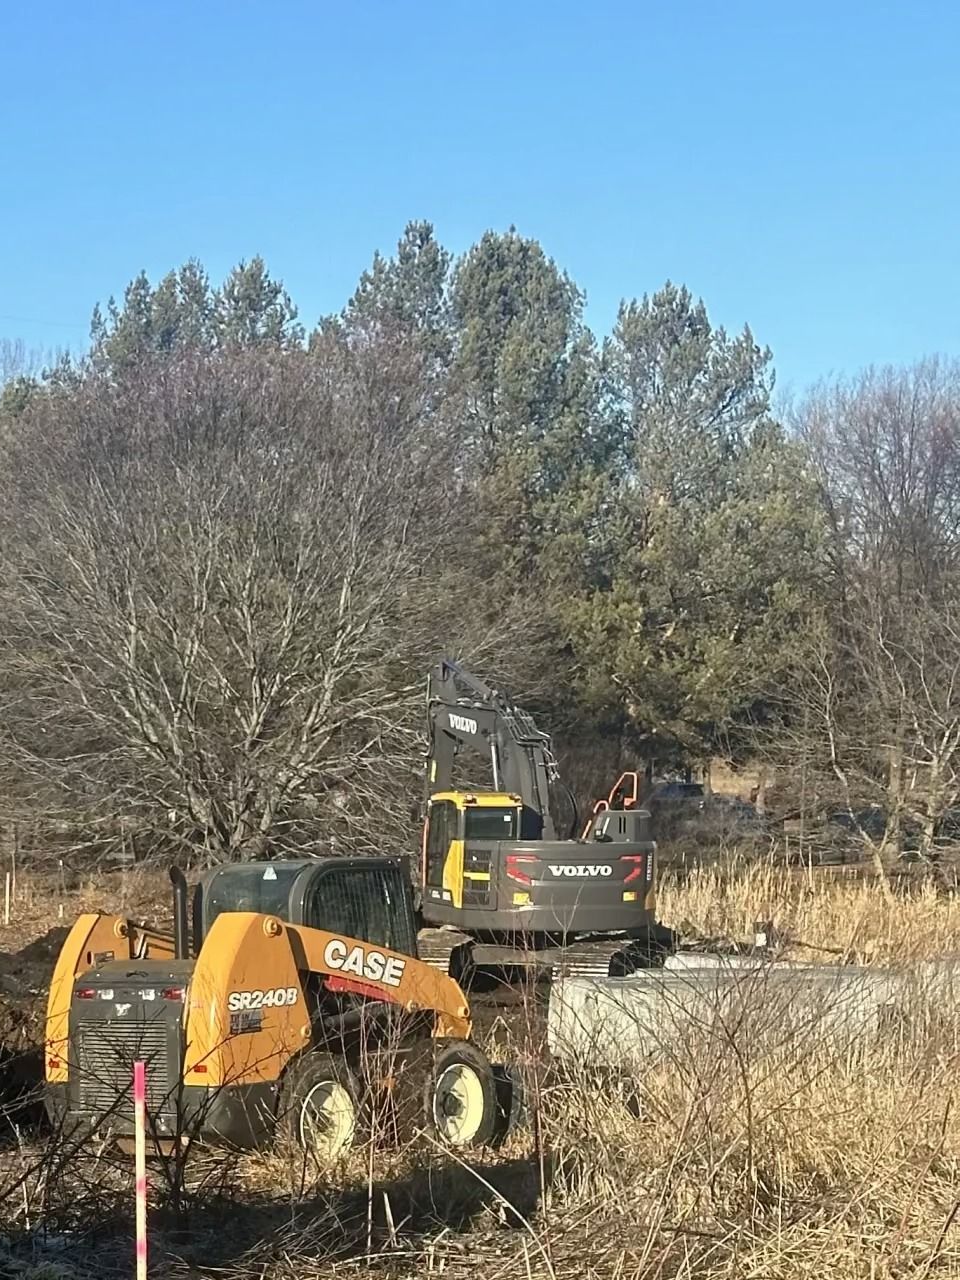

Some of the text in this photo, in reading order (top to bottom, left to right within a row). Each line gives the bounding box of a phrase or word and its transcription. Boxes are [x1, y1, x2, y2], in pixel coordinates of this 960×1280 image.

[448, 713, 477, 735] VOLVO
[547, 865, 613, 877] VOLVO
[323, 939, 407, 987] CASE
[227, 987, 298, 1011] SR240B
